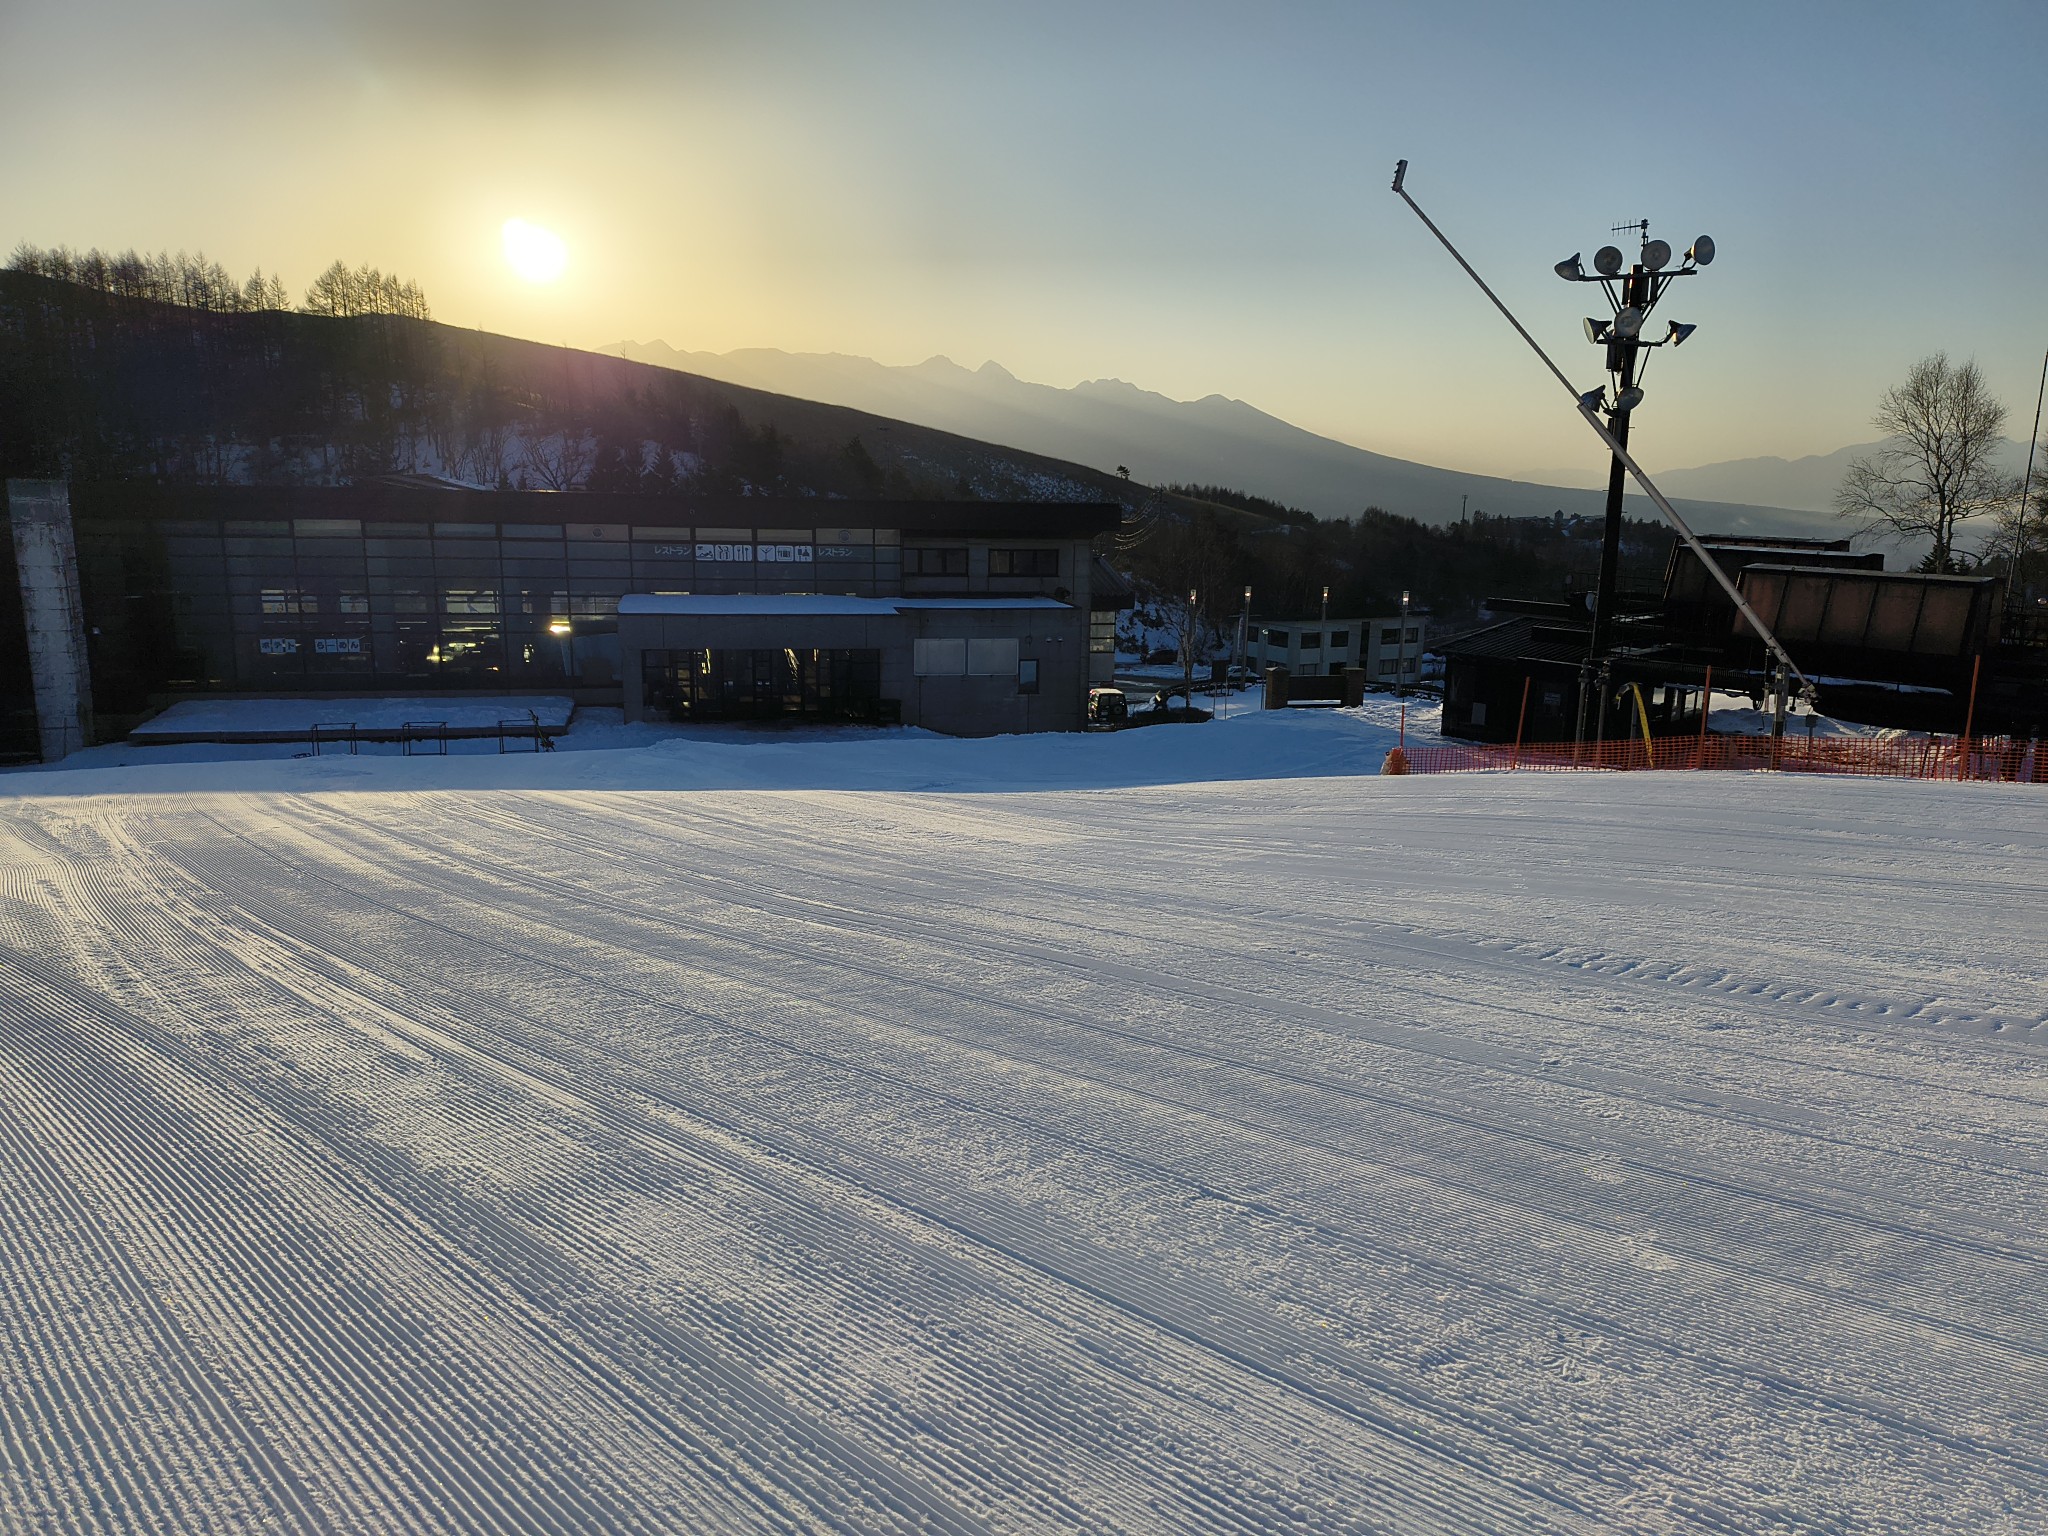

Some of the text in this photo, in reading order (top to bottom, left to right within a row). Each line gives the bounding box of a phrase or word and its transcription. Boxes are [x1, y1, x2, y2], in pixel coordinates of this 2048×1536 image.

[655, 545, 692, 556] レストラン
[818, 547, 853, 557] レストラン
[317, 641, 359, 650] らーめん
